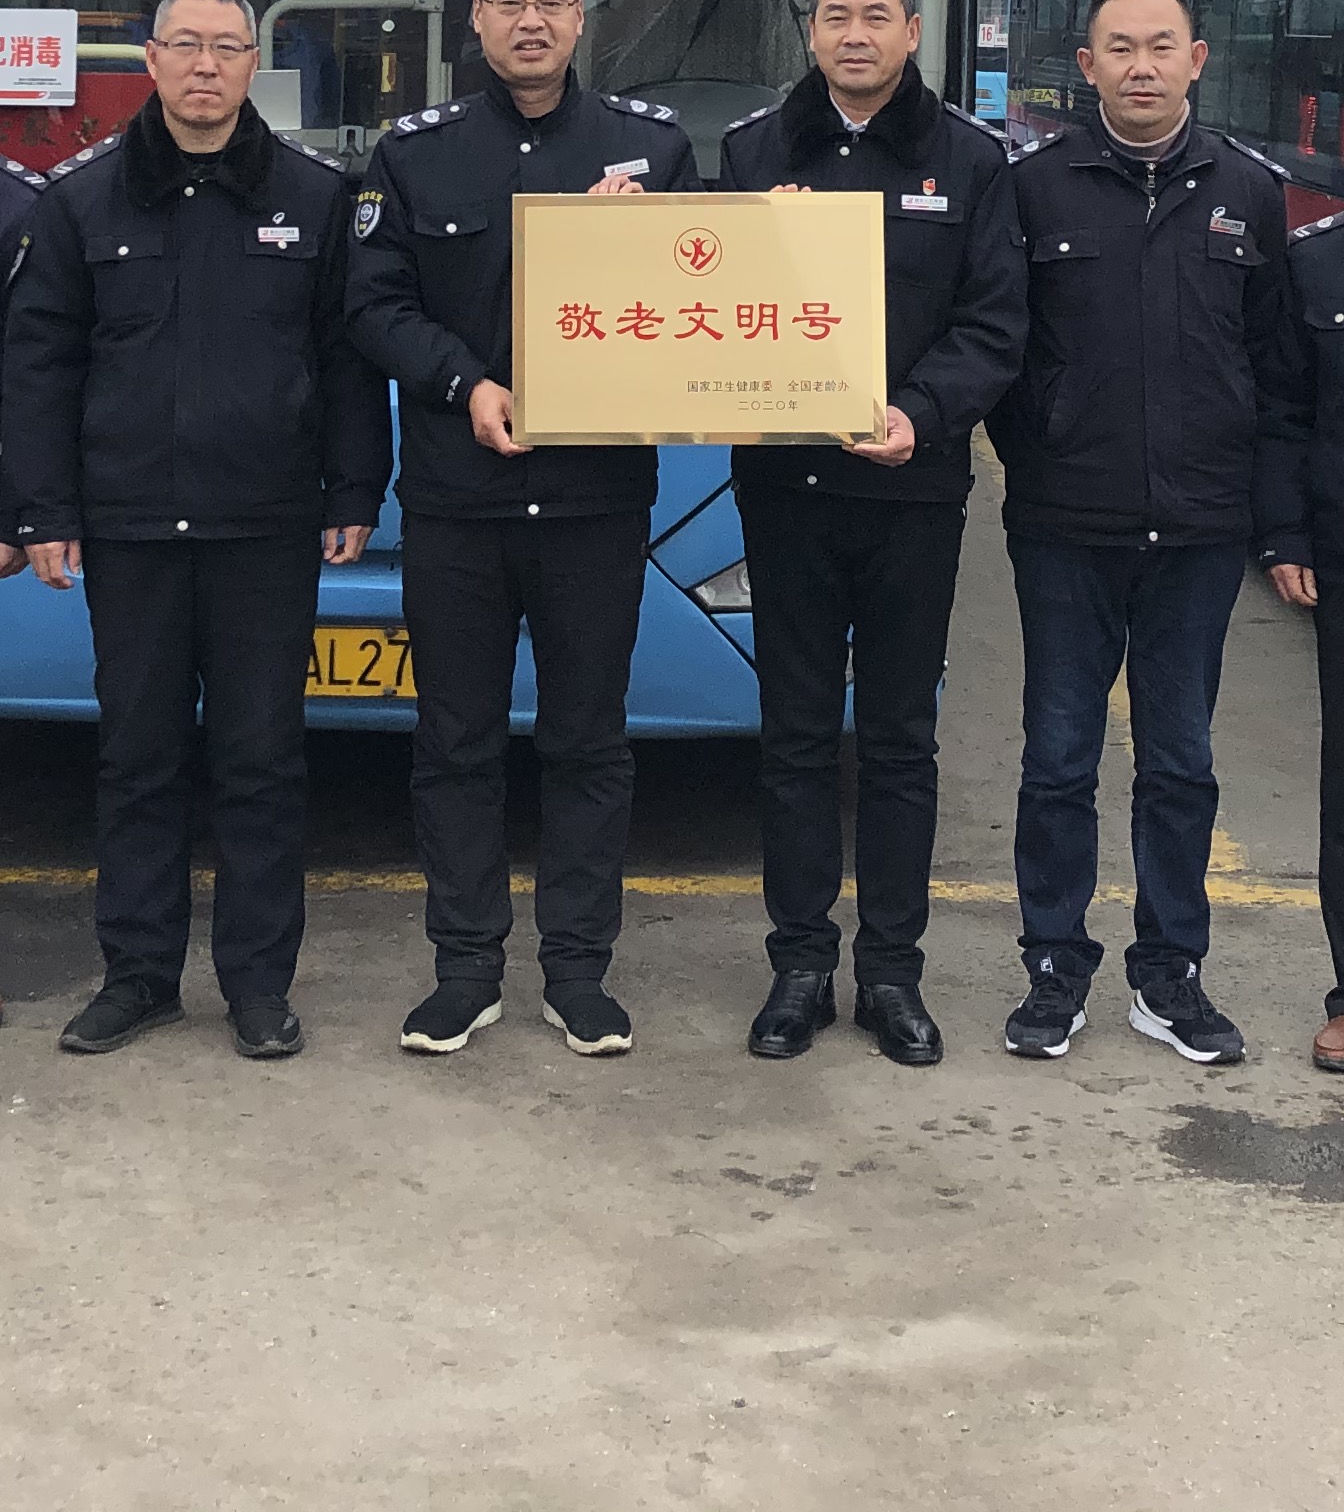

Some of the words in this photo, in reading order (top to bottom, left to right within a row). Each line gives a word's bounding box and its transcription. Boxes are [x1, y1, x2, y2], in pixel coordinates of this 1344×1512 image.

[981, 27, 993, 42] 16
[555, 301, 843, 341] 敬老文明号
[687, 380, 773, 393] 国家卫生健康委
[787, 380, 850, 393] 全国老龄办
